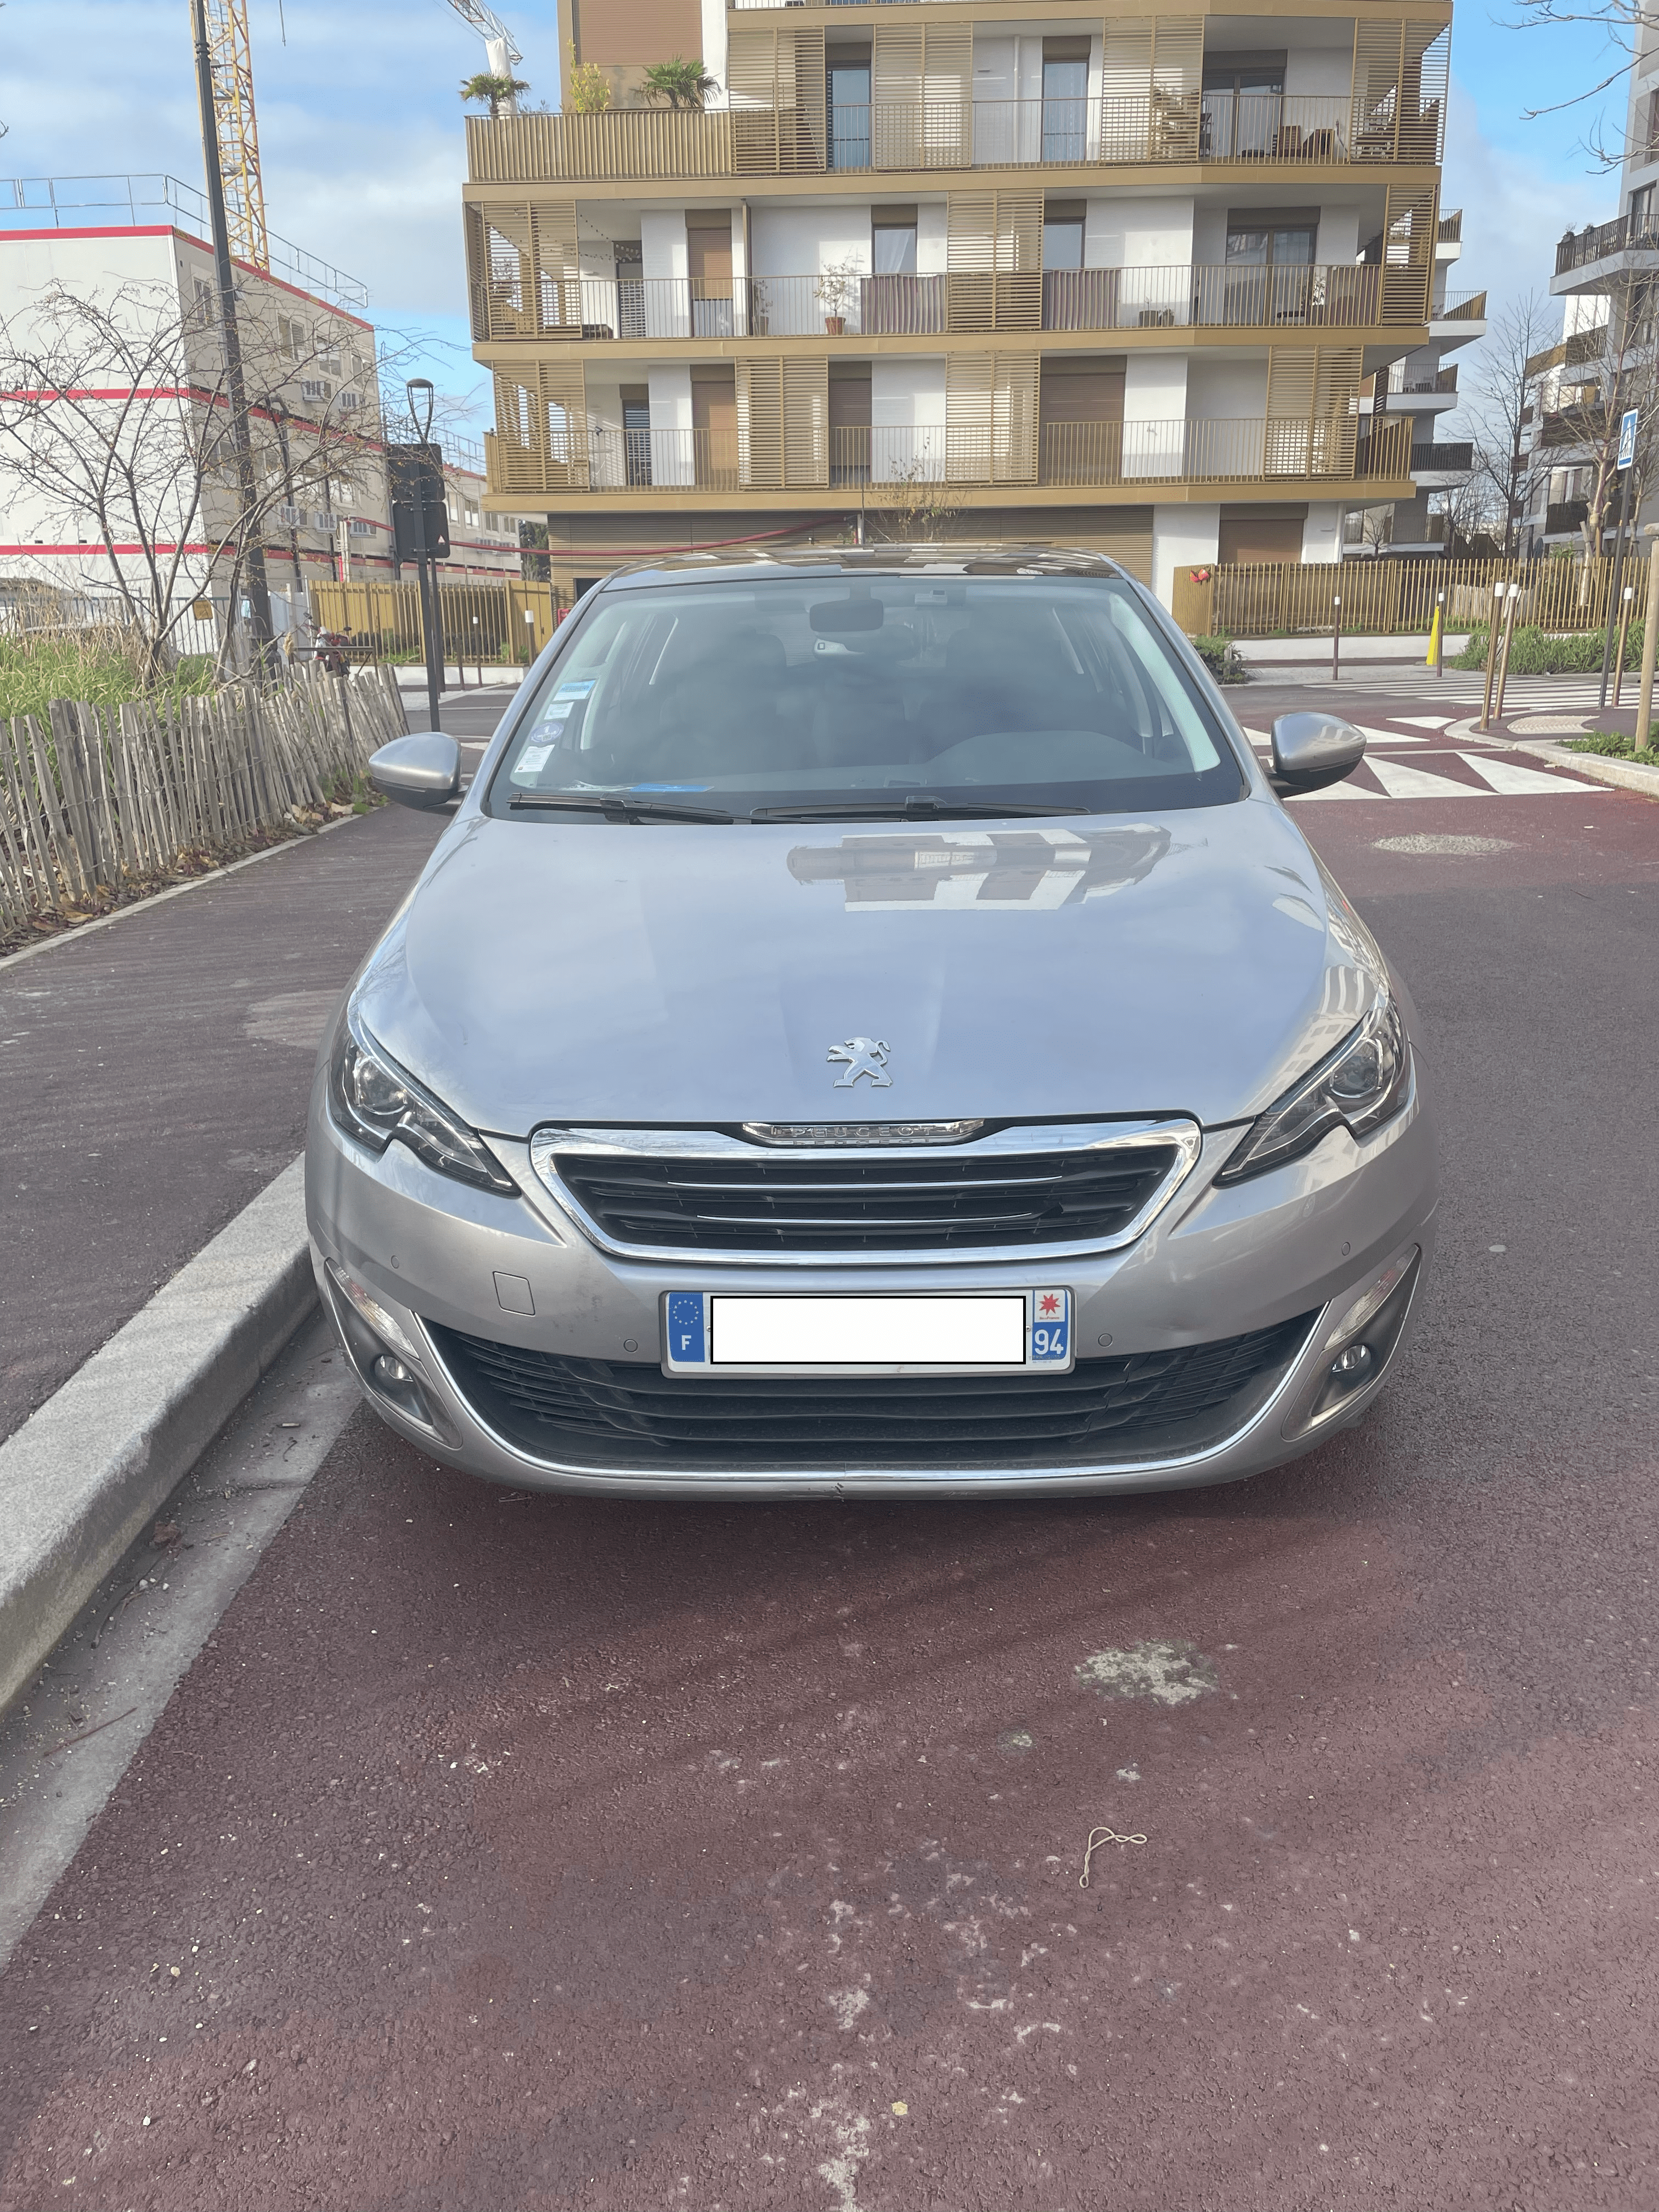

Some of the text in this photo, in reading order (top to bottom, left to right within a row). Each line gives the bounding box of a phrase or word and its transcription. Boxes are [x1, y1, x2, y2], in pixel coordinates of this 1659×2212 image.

[792, 1126, 933, 1137] PEUGEOT
[681, 1335, 691, 1350] F
[1035, 1329, 1064, 1355] 94
